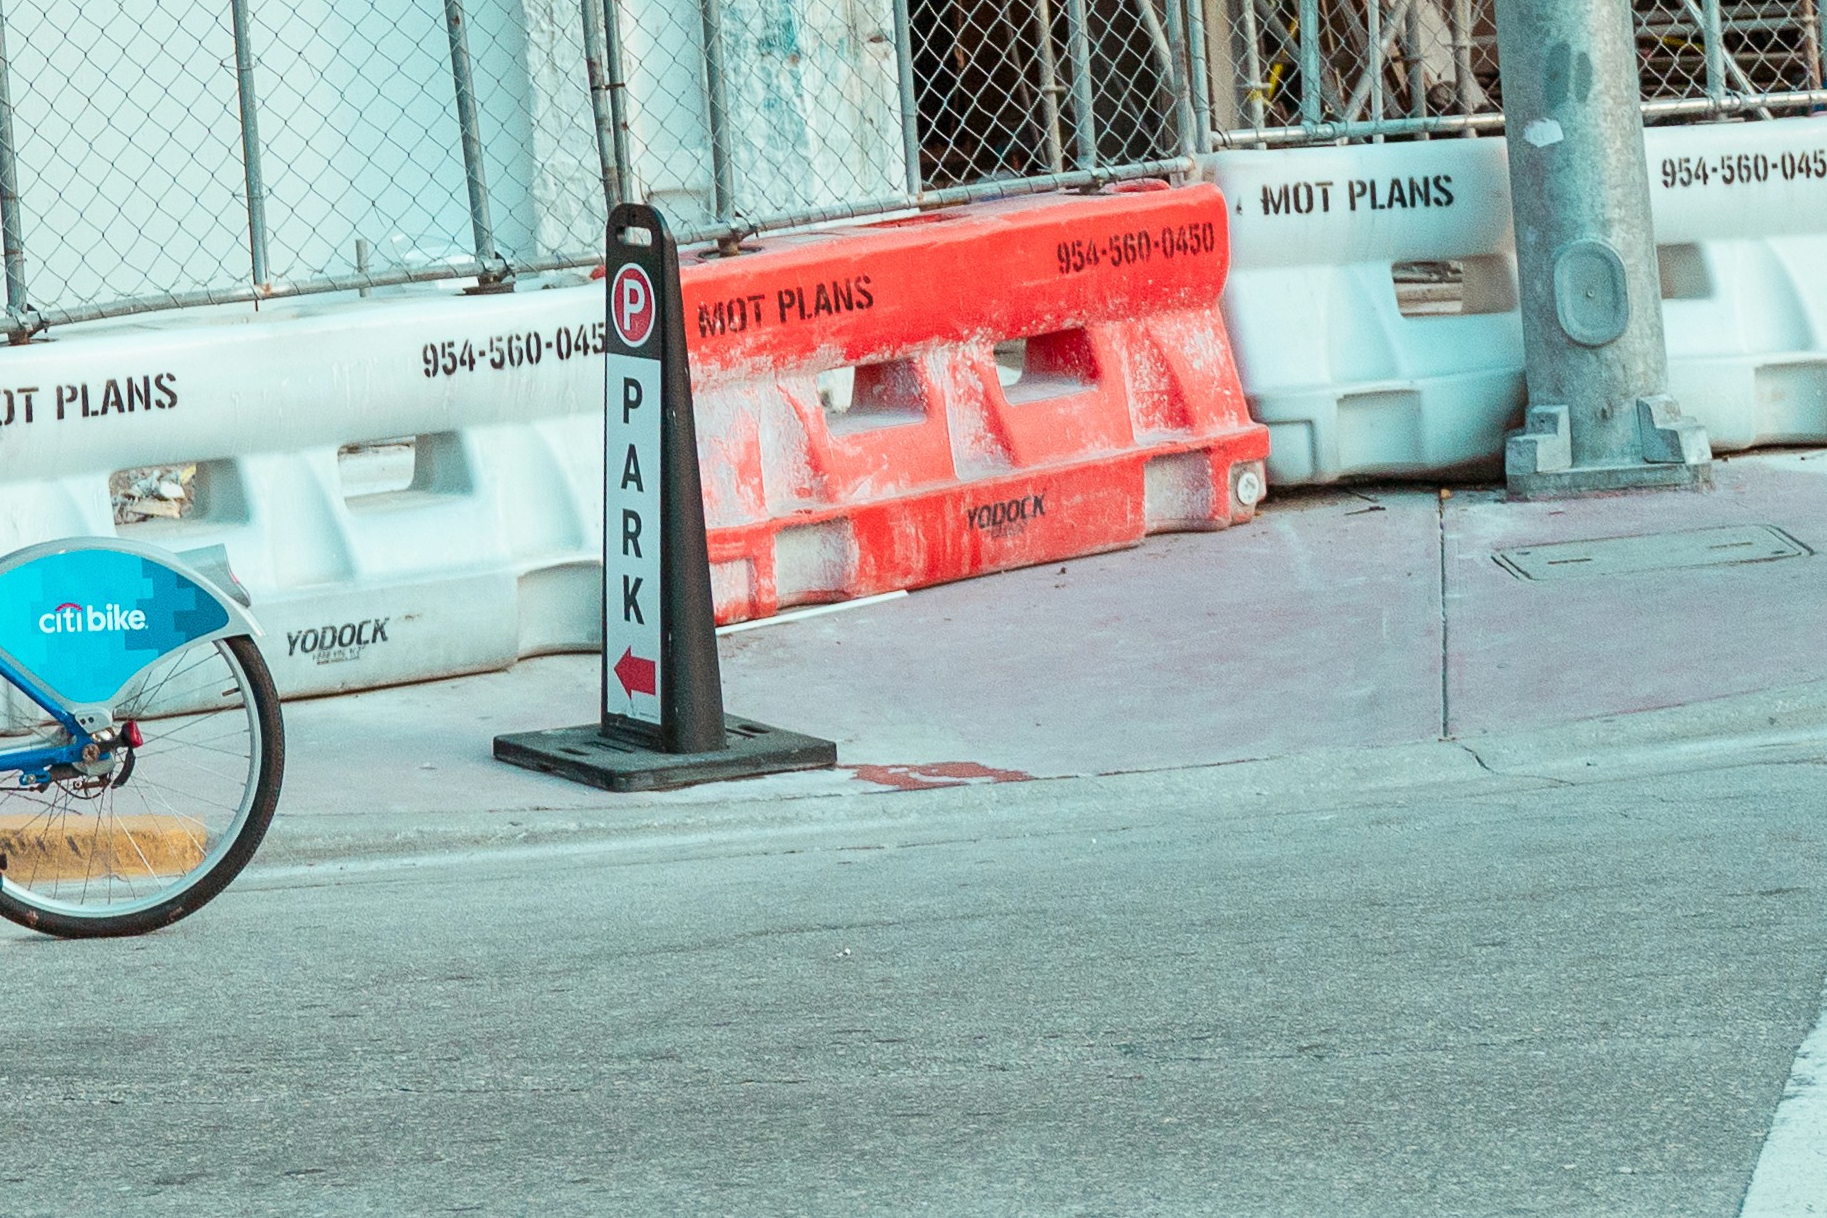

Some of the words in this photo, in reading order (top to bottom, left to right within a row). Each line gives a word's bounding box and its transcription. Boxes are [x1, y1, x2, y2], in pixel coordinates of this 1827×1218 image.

[1260, 181, 1334, 215] MOT
[1348, 174, 1454, 212] PLANS
[1057, 222, 1214, 274] 954-560-0450
[698, 294, 766, 338] MOT
[777, 275, 873, 324] PLANS
[56, 372, 178, 420] PLANS
[621, 376, 644, 625] PARK
[968, 493, 1046, 530] YODOCK
[39, 603, 82, 633] citi
[87, 603, 146, 632] bike
[287, 618, 389, 656] YODOCK
